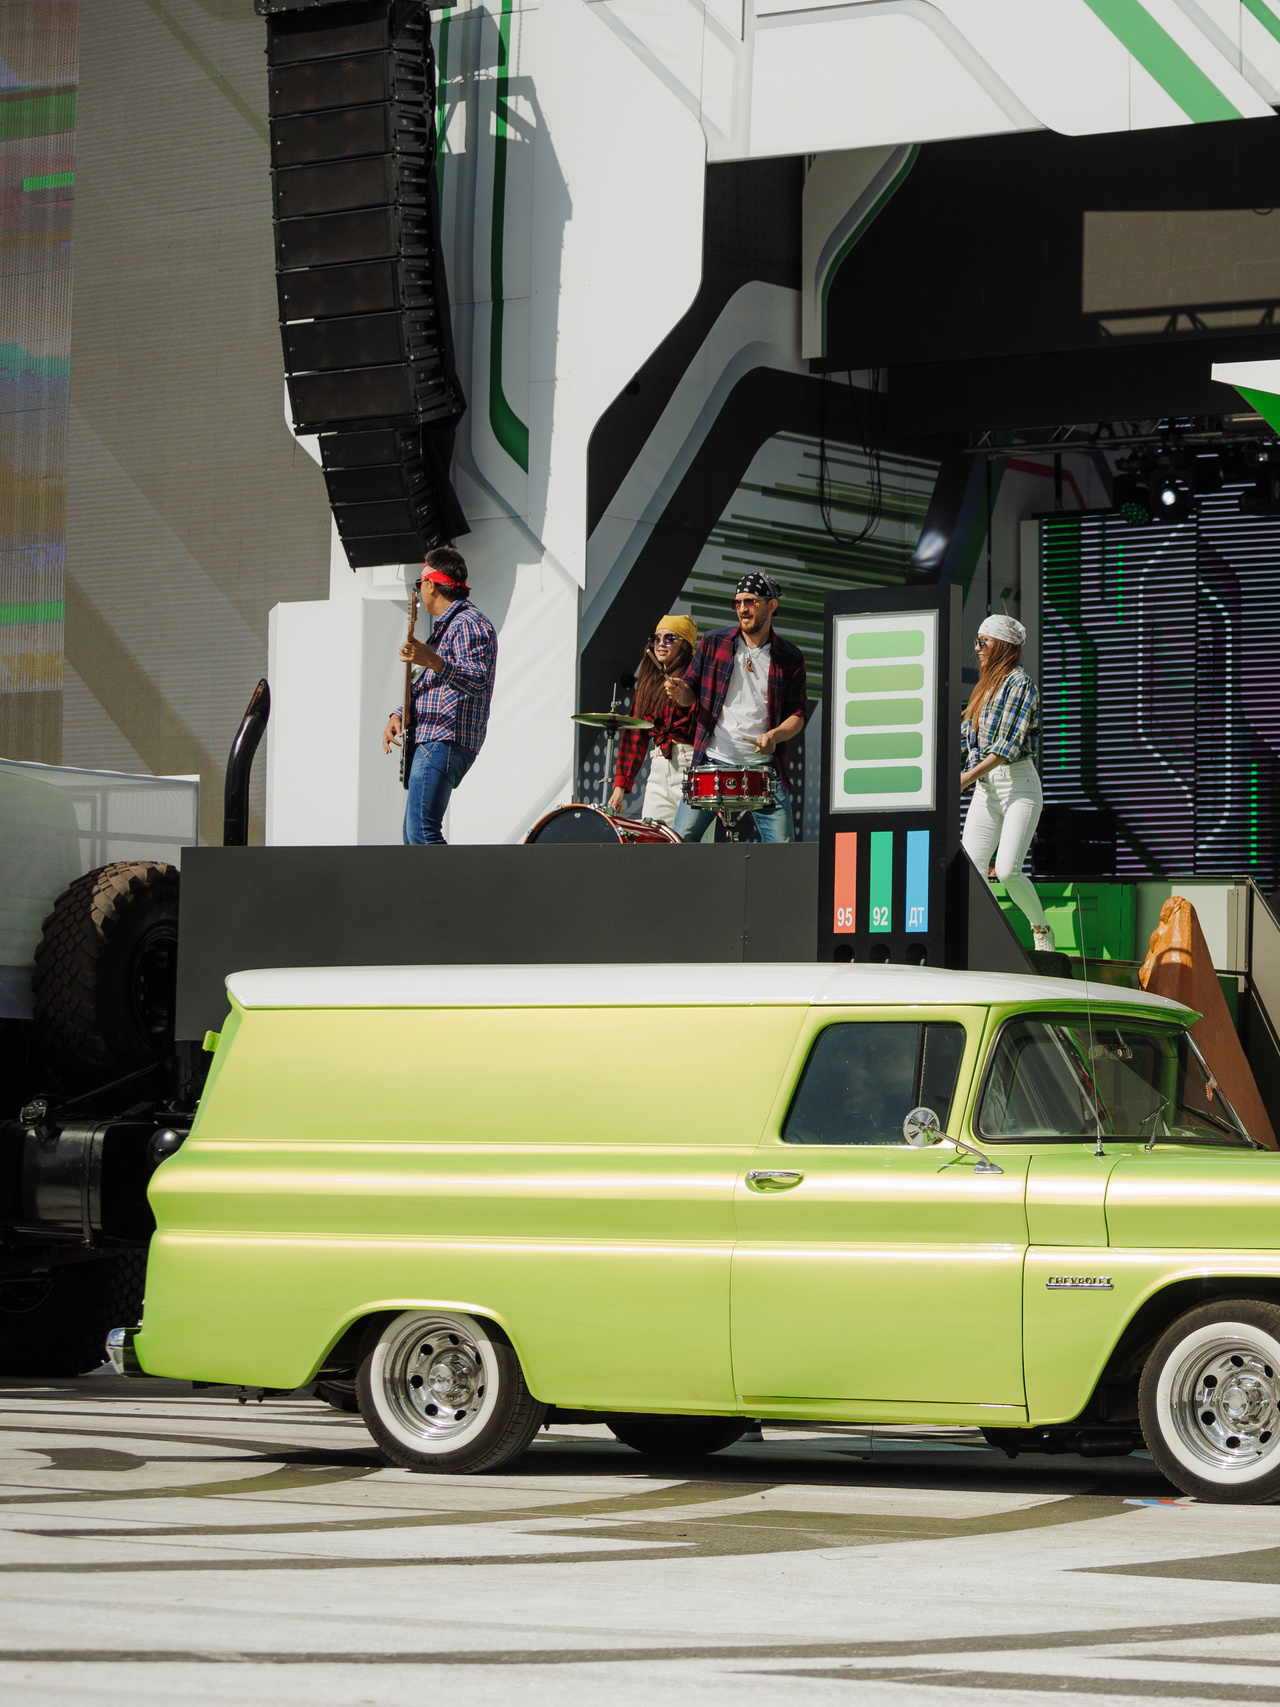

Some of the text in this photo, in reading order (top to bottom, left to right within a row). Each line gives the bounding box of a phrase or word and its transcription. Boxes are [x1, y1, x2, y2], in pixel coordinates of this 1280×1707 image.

[837, 907, 853, 927] 95
[873, 906, 888, 926] 92
[909, 907, 925, 927] ДТ
[1048, 1276, 1112, 1285] CHEVROLET
